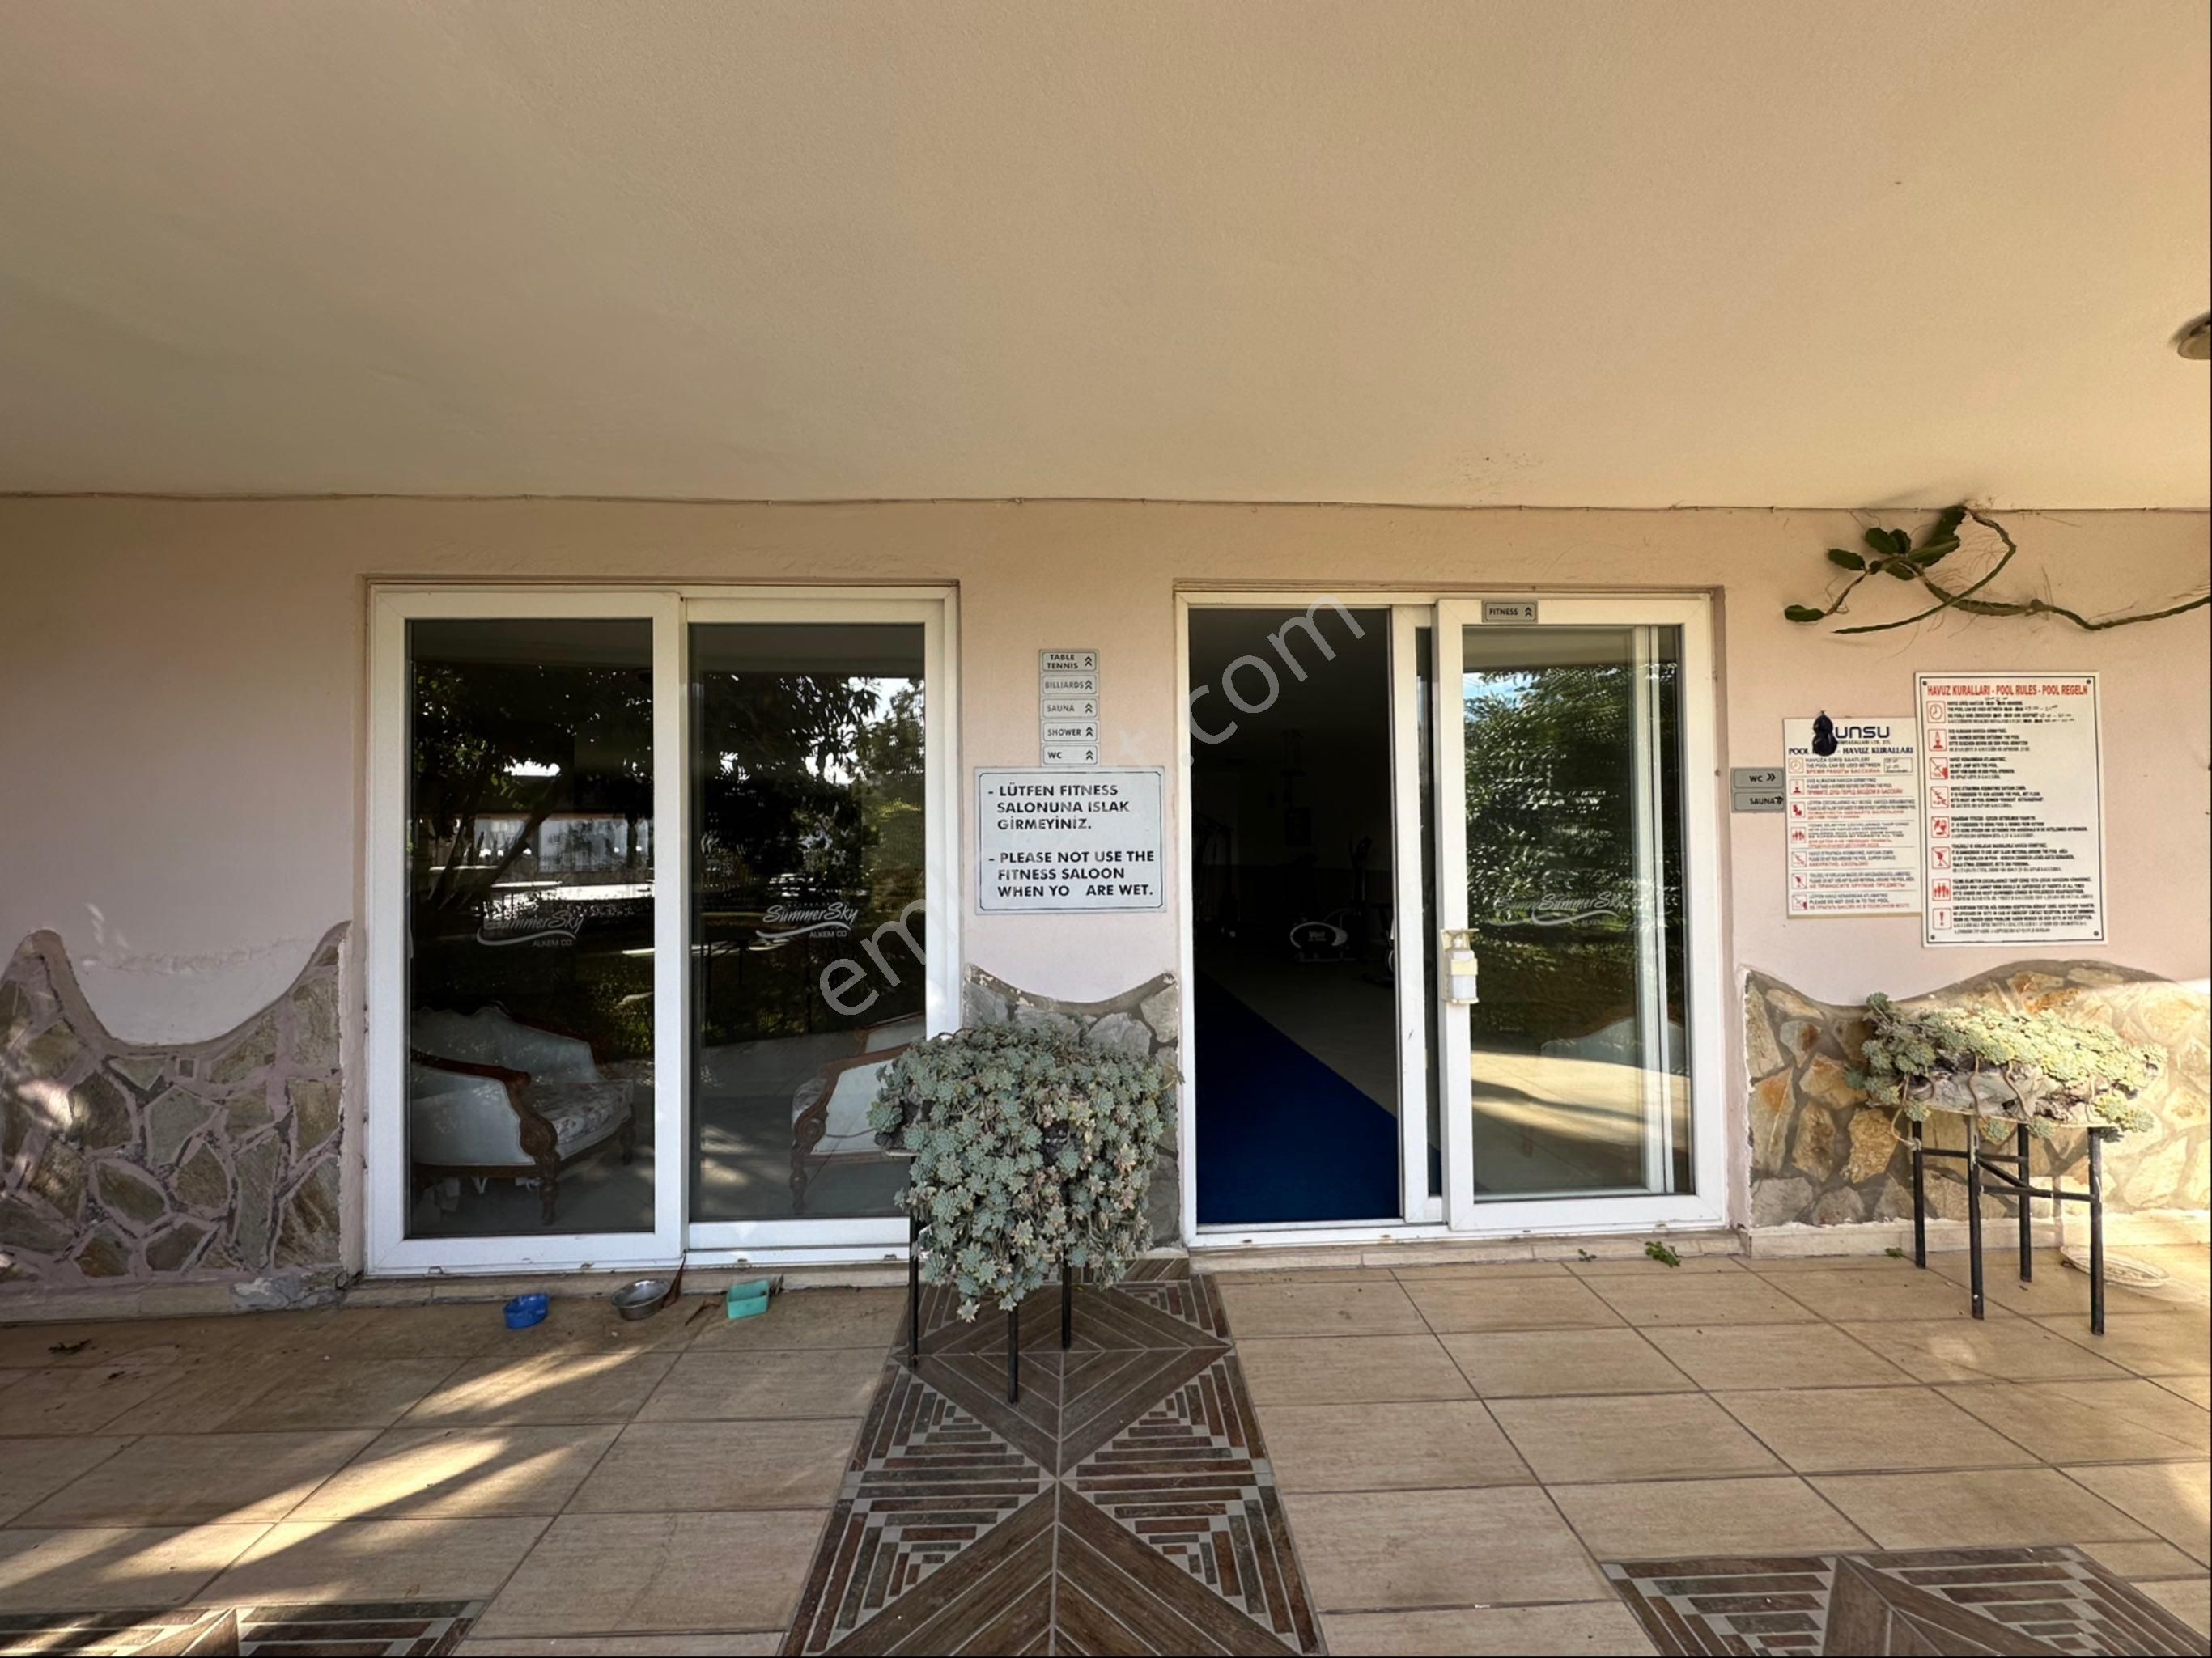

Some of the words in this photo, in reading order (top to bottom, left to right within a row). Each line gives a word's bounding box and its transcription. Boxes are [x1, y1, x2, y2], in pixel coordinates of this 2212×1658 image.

[1927, 685, 1951, 696] HAVUZ
[1952, 685, 1991, 696] KURALLARI
[1996, 685, 2014, 695] POOL
[2016, 685, 2036, 695] RULES
[2042, 685, 2060, 695] POOL
[2061, 685, 2088, 695] REGELN
[1047, 728, 1081, 736] SHOWER
[1047, 751, 1062, 759] WC
[1000, 782, 1055, 796] LÜTFEN
[1060, 785, 1119, 796] FITNESS
[997, 801, 1083, 813] SALONUNA
[1088, 801, 1130, 812] ISLAK
[997, 816, 1092, 830] GİRMEYİNİZ.
[1000, 852, 1051, 863] PLEASE
[1058, 851, 1089, 863] NOT
[1094, 851, 1122, 862] USE
[1127, 850, 1154, 862] THE
[998, 868, 1056, 880] FITNESS
[1061, 868, 1124, 880] SALOON
[998, 886, 1044, 897] WHEN
[1086, 884, 1114, 896] ARE
[1119, 884, 1153, 896] WET.
